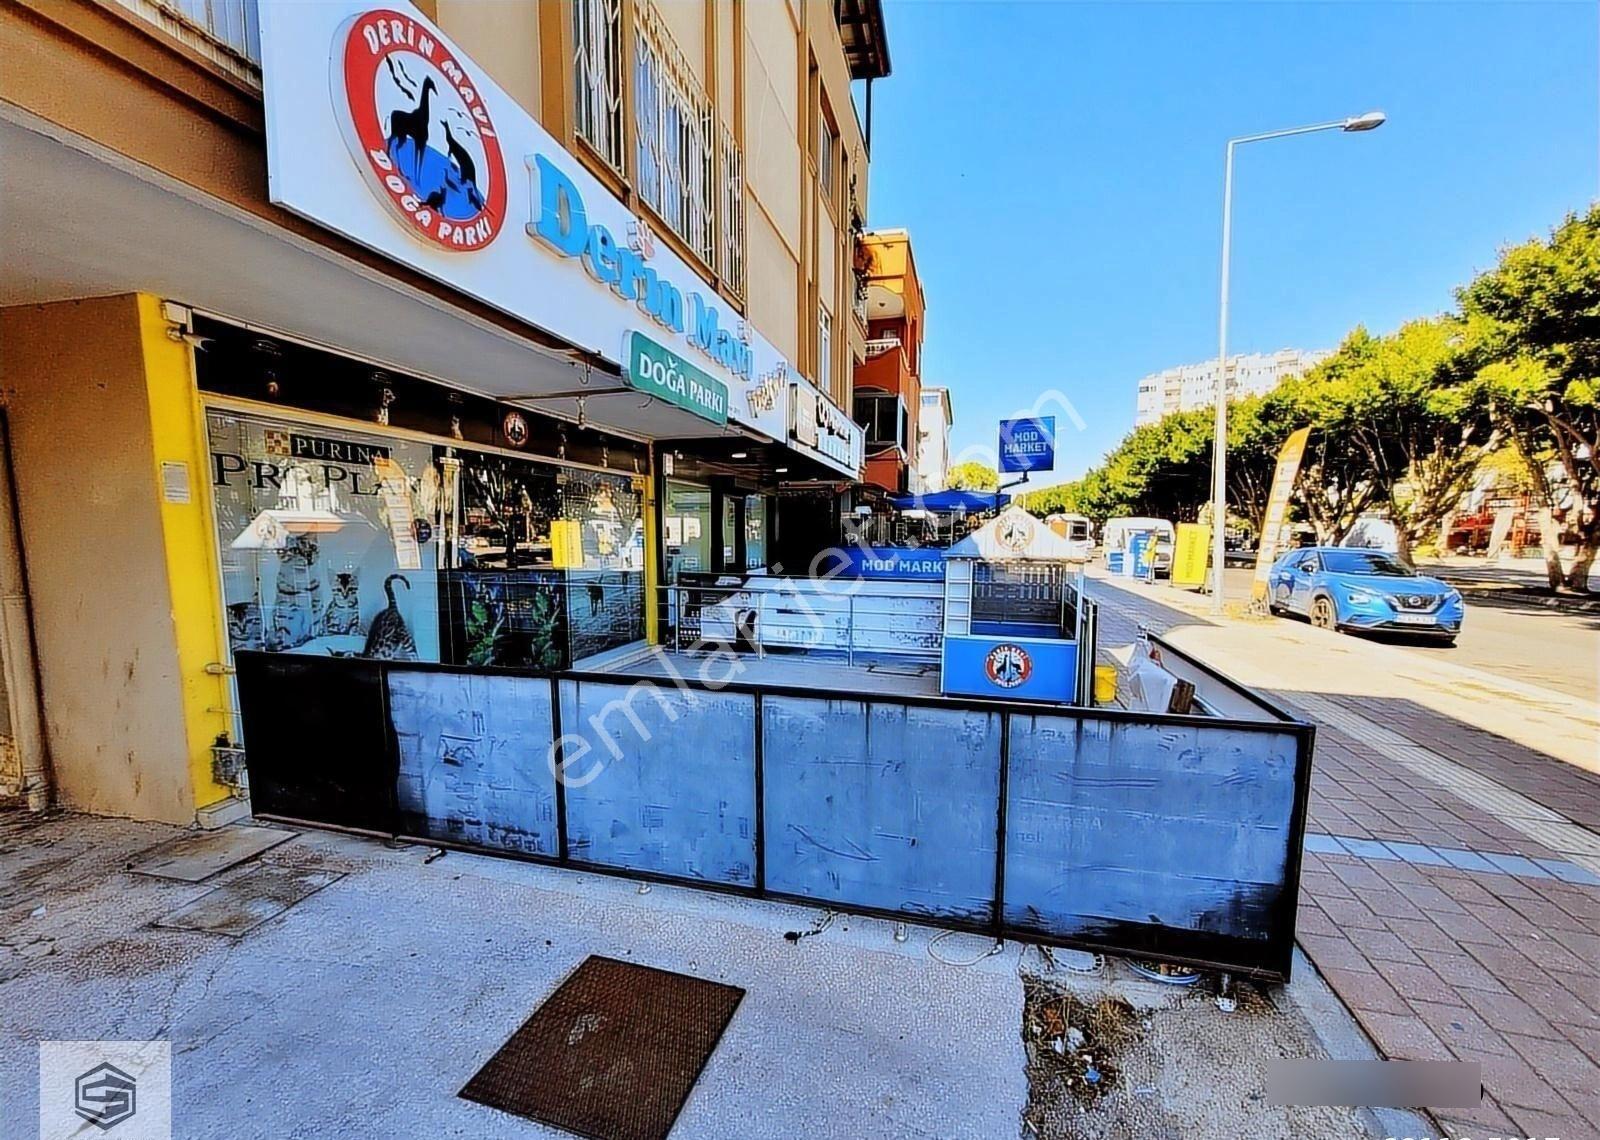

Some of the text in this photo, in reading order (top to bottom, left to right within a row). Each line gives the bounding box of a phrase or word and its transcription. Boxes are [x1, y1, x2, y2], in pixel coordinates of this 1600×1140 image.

[370, 150, 492, 246] DOĞA PARKI
[639, 352, 686, 397] DOĞA
[690, 379, 723, 415] PARKI
[1013, 431, 1038, 442] MOD
[1004, 441, 1047, 454] MARKET
[862, 559, 894, 572] MOD
